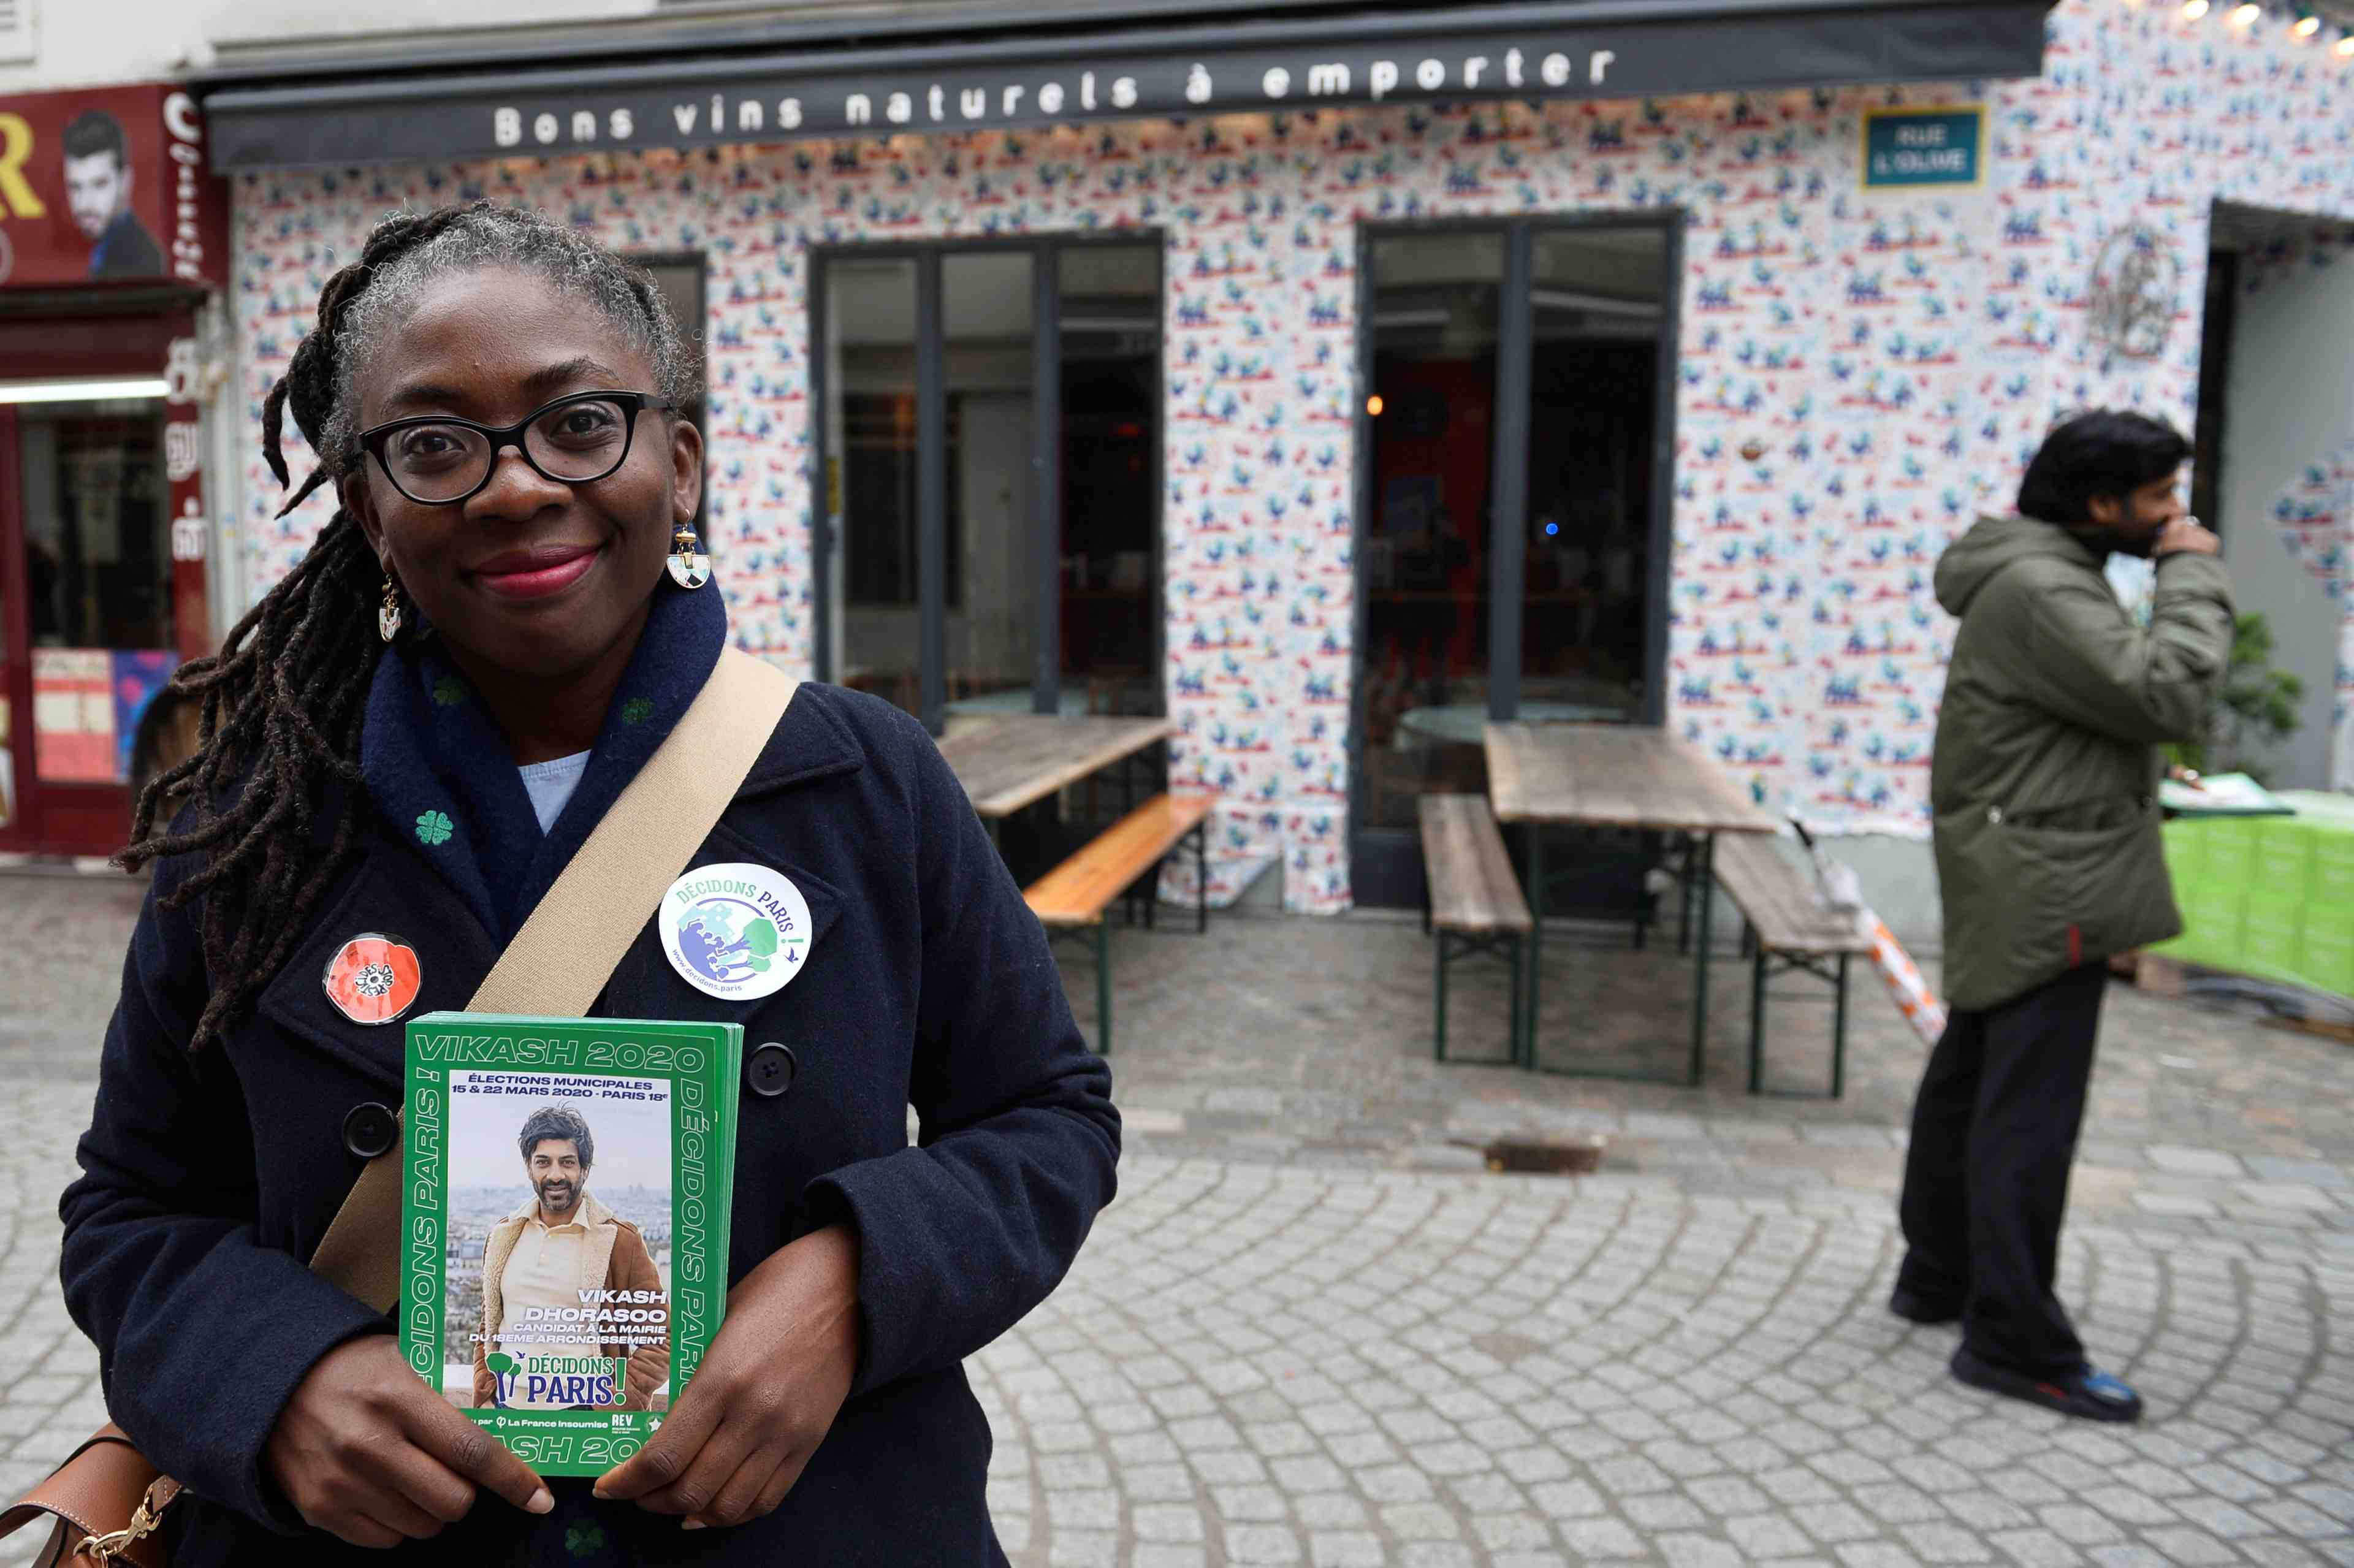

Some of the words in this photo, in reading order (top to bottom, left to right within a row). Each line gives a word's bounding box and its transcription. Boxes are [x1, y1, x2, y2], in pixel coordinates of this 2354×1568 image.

[494, 106, 633, 147] Bons
[674, 93, 802, 135] vins
[846, 70, 1138, 124] naturels
[1186, 62, 1213, 104] à
[1262, 48, 1615, 101] emporter
[1894, 124, 1948, 148] RUE
[676, 880, 756, 904] DÉCIDONS
[757, 891, 794, 932] PARIS
[415, 1035, 579, 1065] VIKASH
[584, 1041, 705, 1073] 2020
[468, 1073, 551, 1086] ÉLECTIONS
[554, 1077, 653, 1090] MUNICIPALES
[470, 1085, 481, 1094] &
[483, 1086, 503, 1095] 22
[505, 1086, 549, 1096] MARS
[552, 1087, 593, 1097] 2020
[601, 1089, 647, 1100] PARIS
[414, 1089, 440, 1210] PARIS
[680, 1077, 710, 1283] DÉCIDONS
[577, 1289, 668, 1304] VIKASH
[525, 1307, 667, 1323] DHORASOO
[513, 1323, 584, 1333] CANDIDAT
[584, 1322, 595, 1333] À
[599, 1325, 617, 1334] LA
[619, 1325, 667, 1334] MAIRIE
[468, 1333, 492, 1342] DU
[537, 1335, 667, 1344] ARRONDISSEMENT
[528, 1353, 614, 1374] DÉCIDONS
[522, 1419, 557, 1428] France
[612, 1414, 633, 1426] REV
